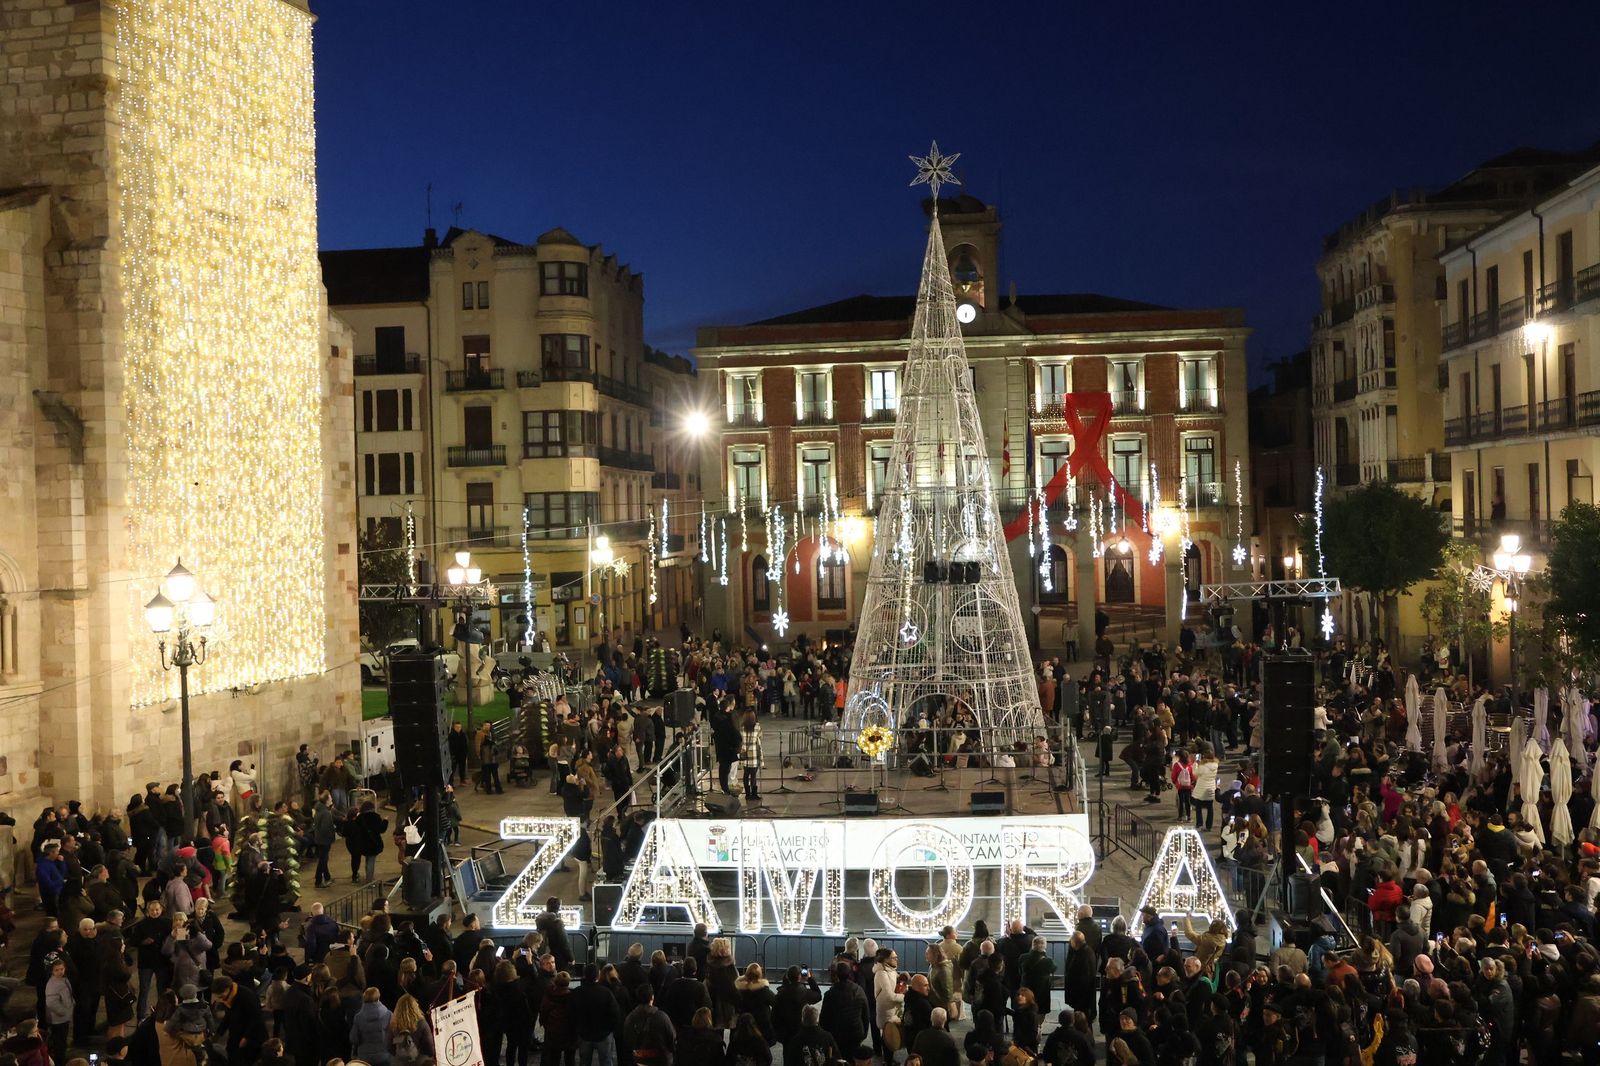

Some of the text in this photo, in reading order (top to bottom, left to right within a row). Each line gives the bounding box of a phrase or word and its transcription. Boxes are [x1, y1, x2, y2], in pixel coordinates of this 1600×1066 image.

[732, 836, 829, 847] AYUTMIENTO
[939, 832, 1039, 845] ANTAMENO
[732, 848, 830, 862] DE AMOR
[966, 846, 1040, 861] ZAMOA
[493, 816, 1237, 941] ZAMORA
